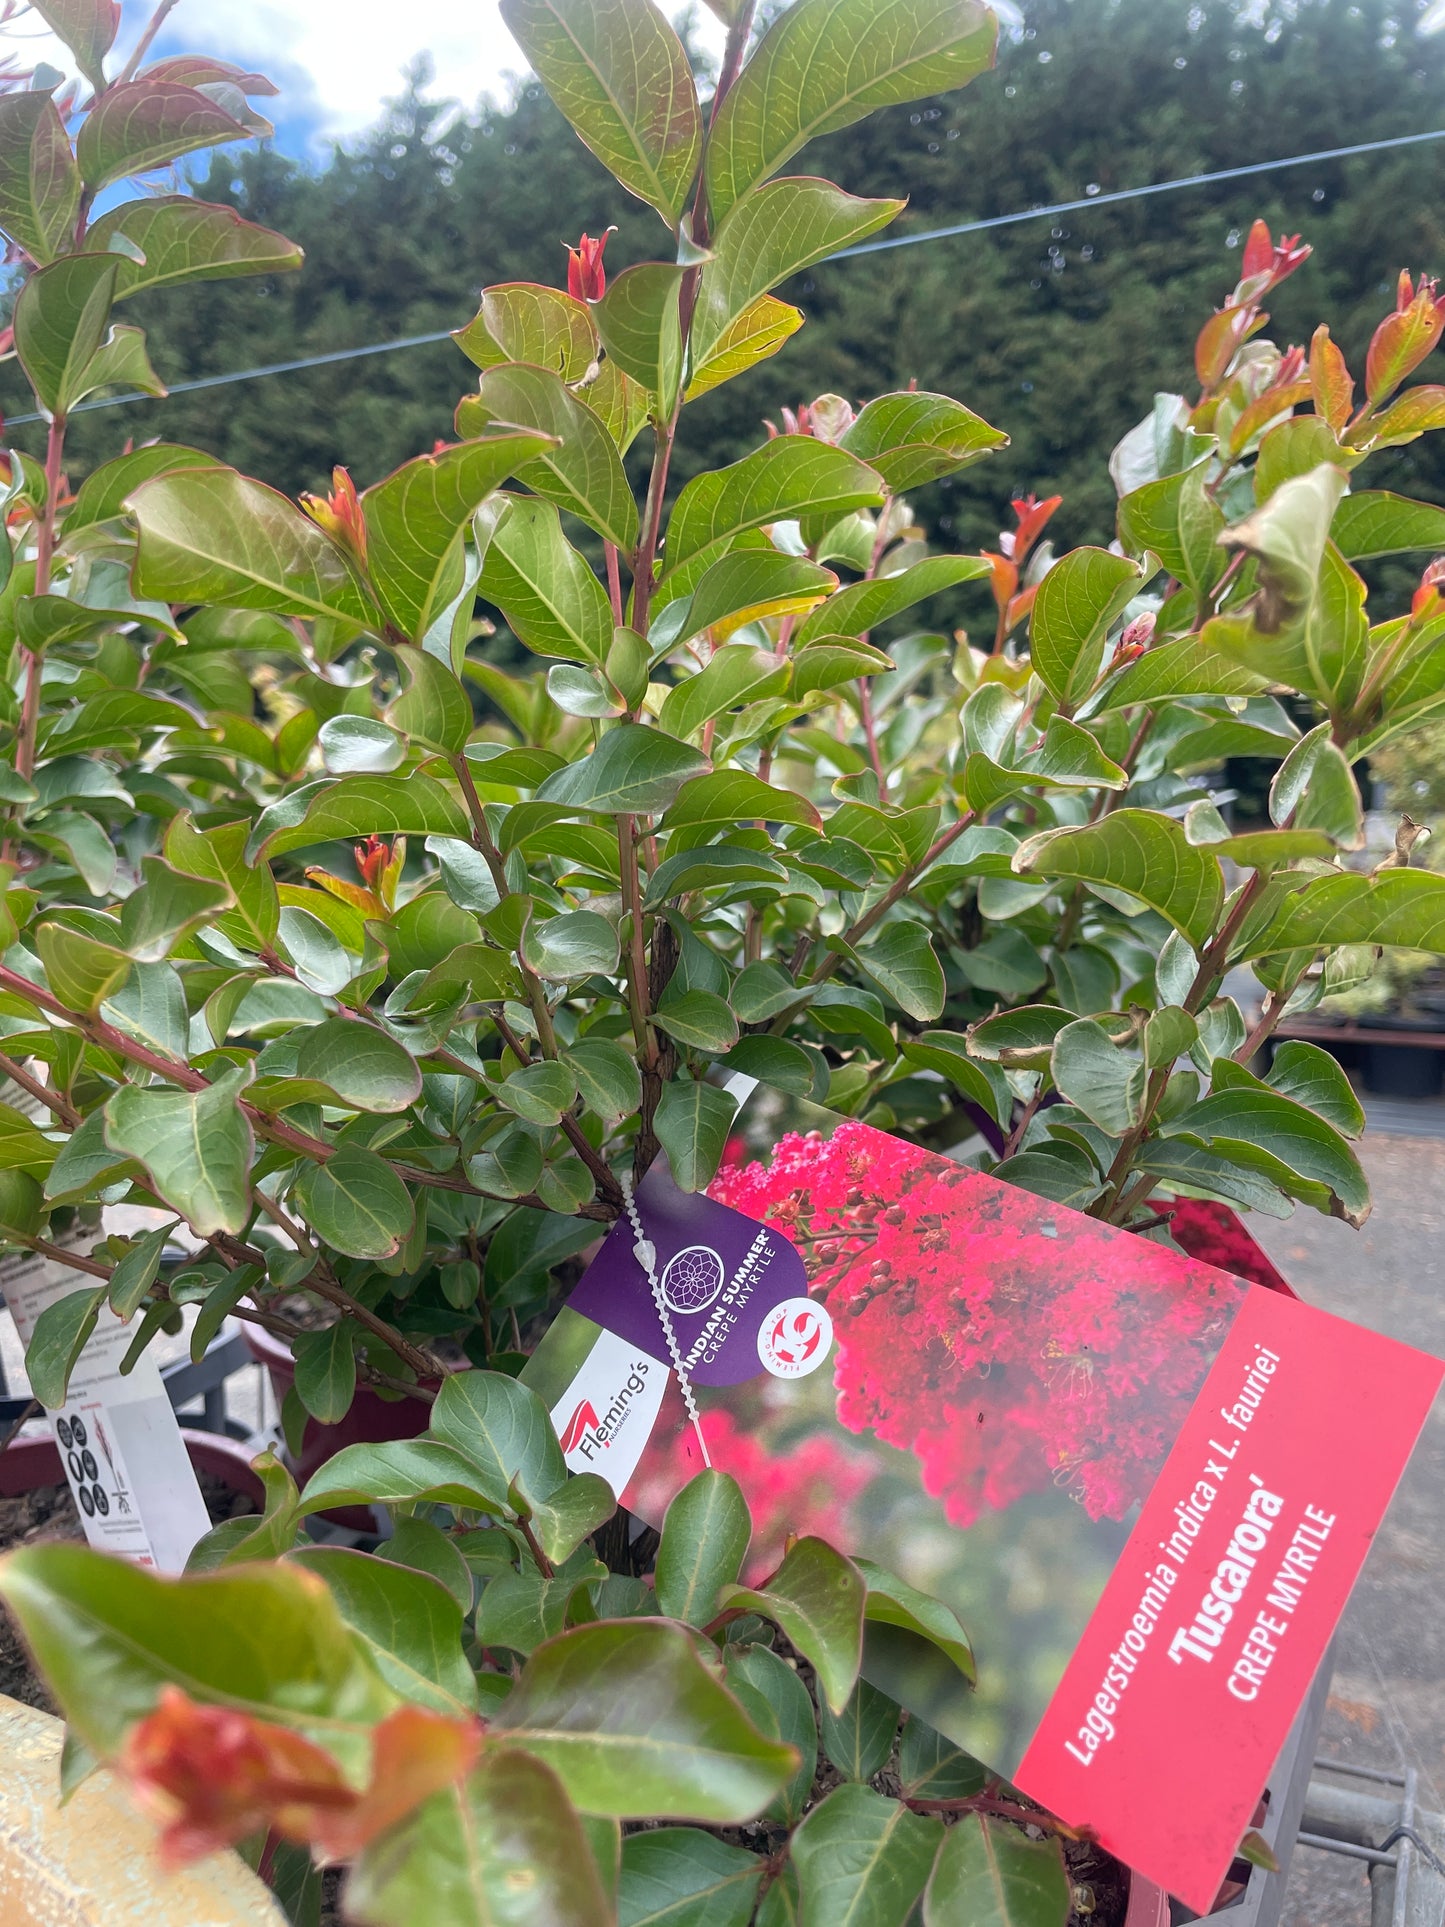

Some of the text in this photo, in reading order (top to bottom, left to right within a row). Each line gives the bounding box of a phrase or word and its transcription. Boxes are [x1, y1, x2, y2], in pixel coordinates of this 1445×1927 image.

[683, 1305, 727, 1370] INDIAN
[703, 1246, 776, 1364] CREPE MYRTLE
[578, 1361, 649, 1462] Fleming's
[608, 1407, 632, 1443] NURSERIES
[1064, 1343, 1280, 1767] Lagerstroemia indica x L. fauriei
[1227, 1503, 1337, 1702] CREPE MYRTLE
